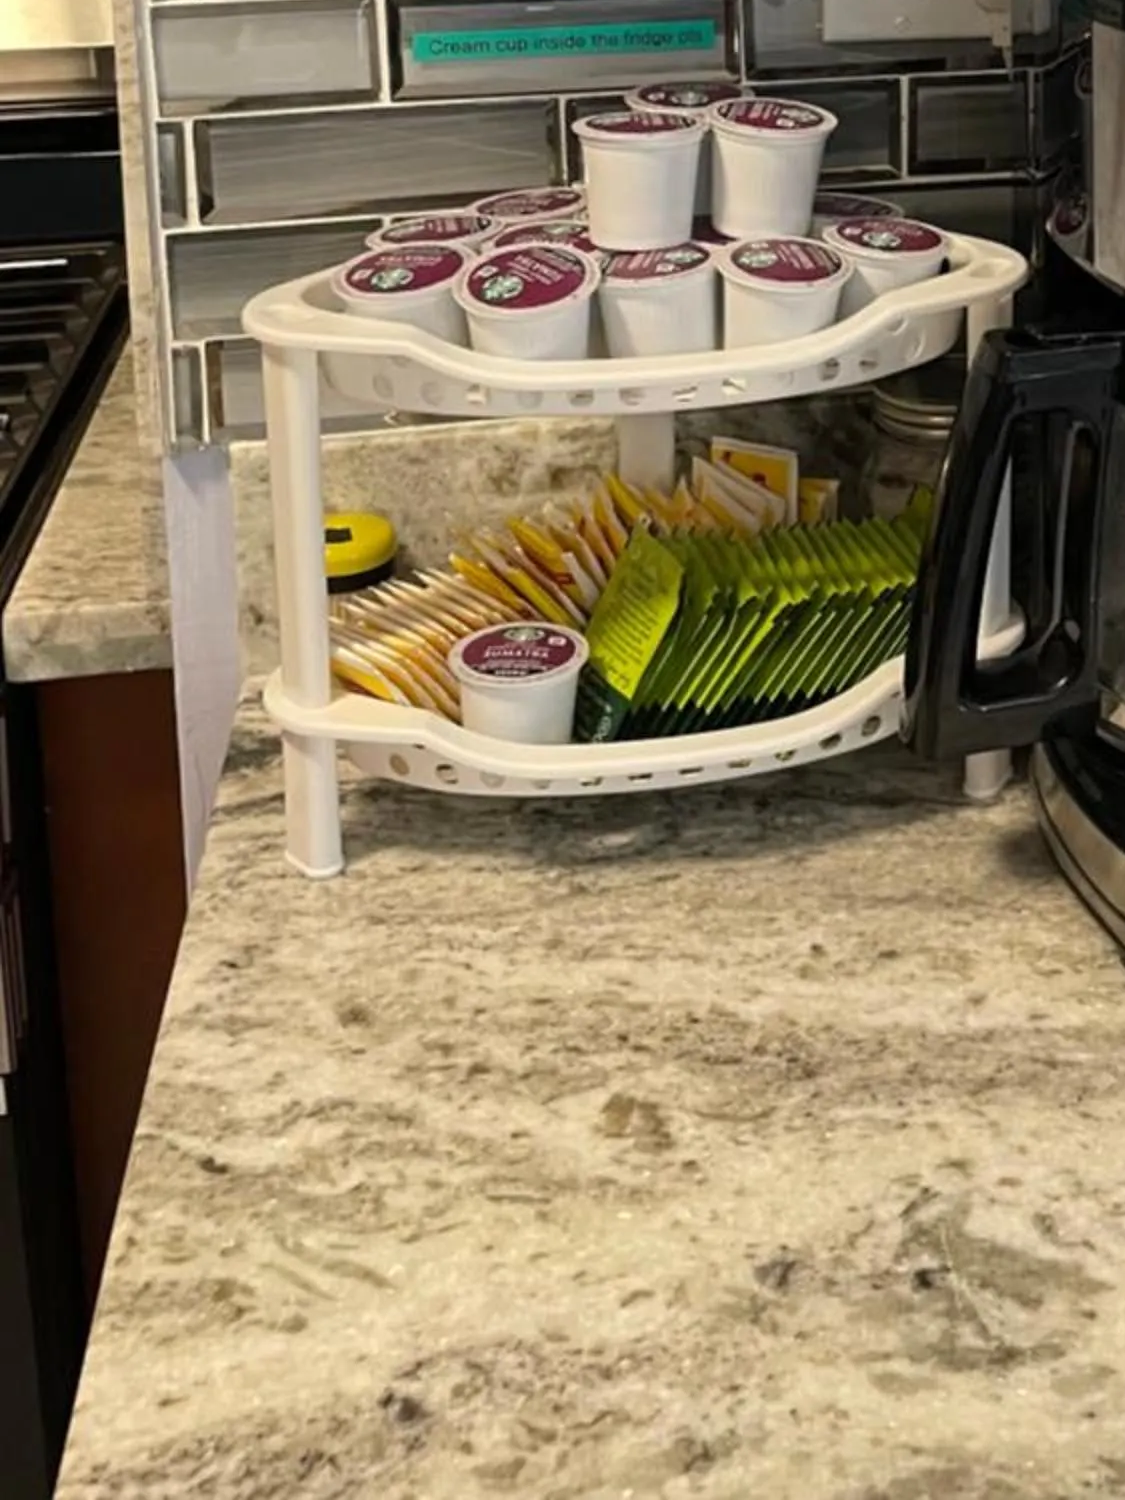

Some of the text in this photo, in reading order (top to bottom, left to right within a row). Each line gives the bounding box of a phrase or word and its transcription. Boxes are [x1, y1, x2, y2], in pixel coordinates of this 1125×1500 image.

[429, 39, 490, 56] Cream
[495, 38, 528, 52] cup
[533, 34, 587, 50] inside
[591, 32, 620, 47] the
[623, 29, 673, 47] fridge
